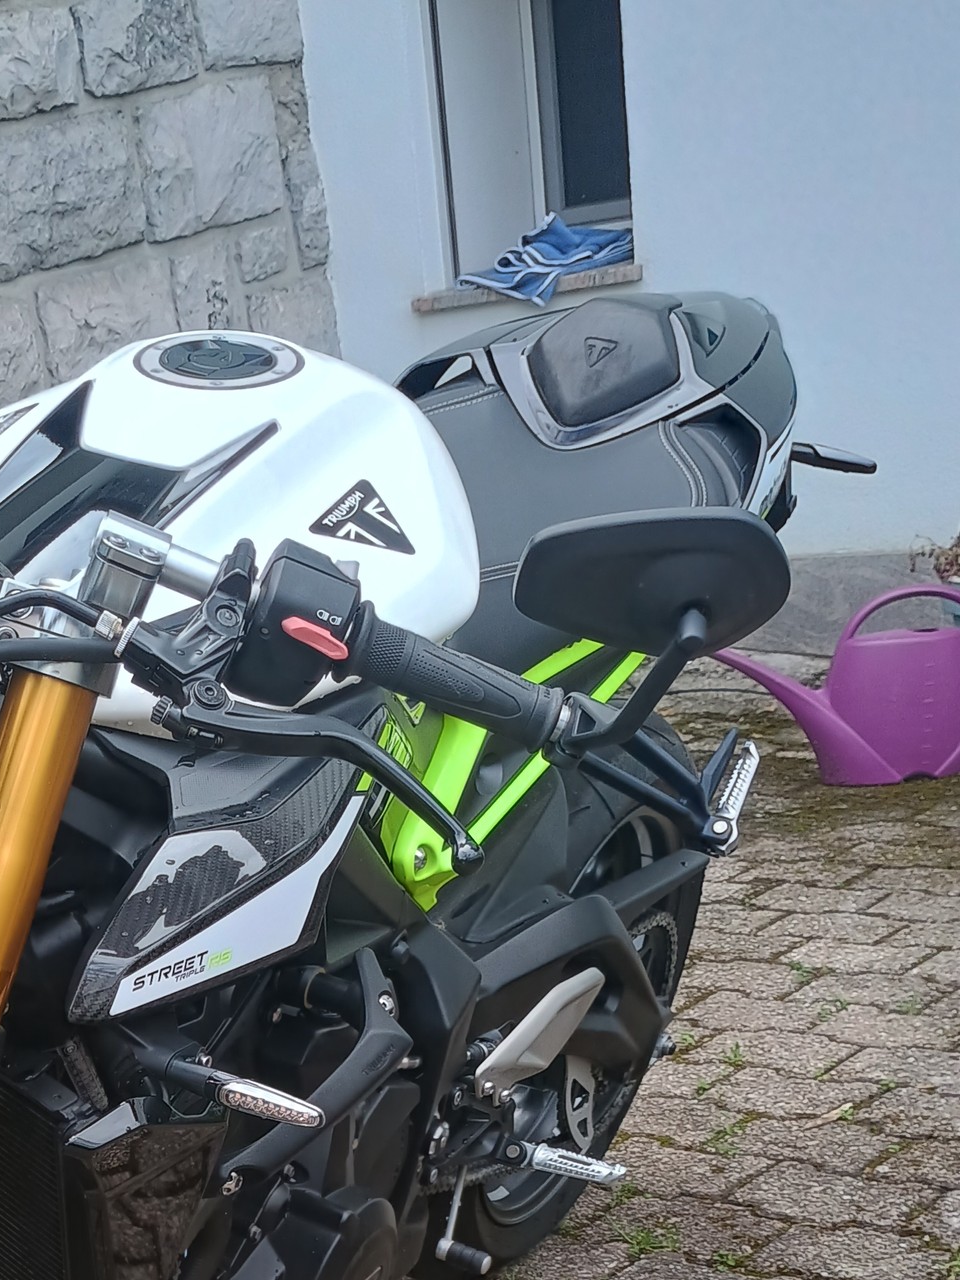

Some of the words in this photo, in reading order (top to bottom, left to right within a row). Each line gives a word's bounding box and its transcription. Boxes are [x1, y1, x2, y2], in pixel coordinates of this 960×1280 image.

[322, 490, 365, 527] TRIUMPH
[132, 950, 209, 992] STREET
[208, 947, 233, 970] RS
[175, 965, 206, 983] TRIPLE
